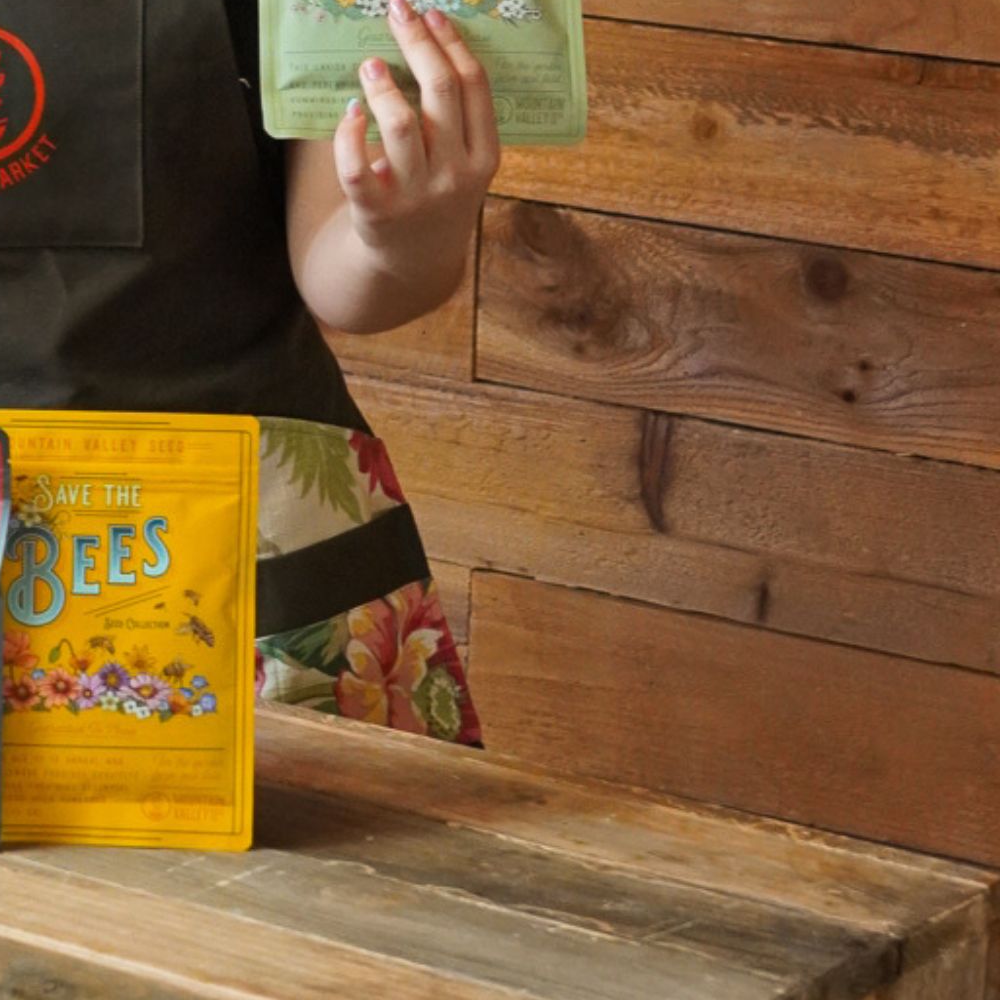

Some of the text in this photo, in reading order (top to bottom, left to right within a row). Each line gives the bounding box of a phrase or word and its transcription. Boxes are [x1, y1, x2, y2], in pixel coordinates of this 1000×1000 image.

[84, 439, 137, 452] VALLEY
[150, 440, 185, 453] SEED
[34, 475, 142, 511] SAVE THE
[5, 516, 170, 627] BEES
